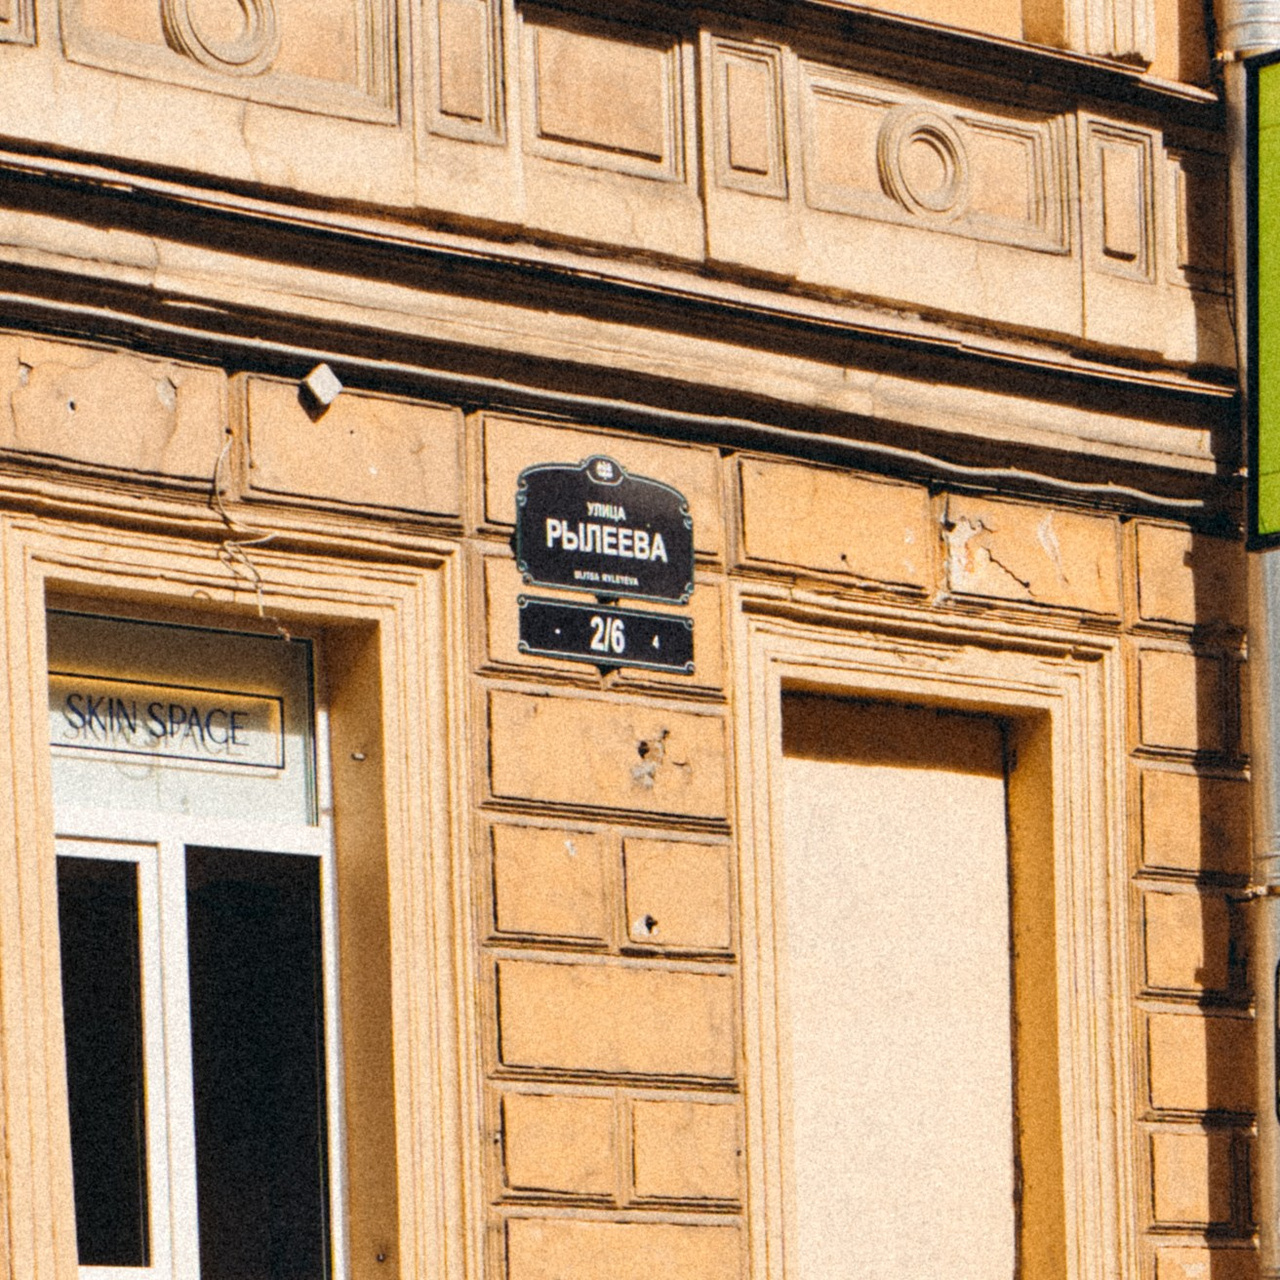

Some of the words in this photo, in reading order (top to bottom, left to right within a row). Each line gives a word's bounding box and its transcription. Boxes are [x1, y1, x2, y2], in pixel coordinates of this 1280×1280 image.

[586, 501, 627, 522] УЛИЦА
[546, 517, 668, 563] РЫЛЕЕВА
[590, 616, 625, 654] 2/6
[65, 693, 137, 734] SKIN
[146, 702, 250, 747] SPACE
